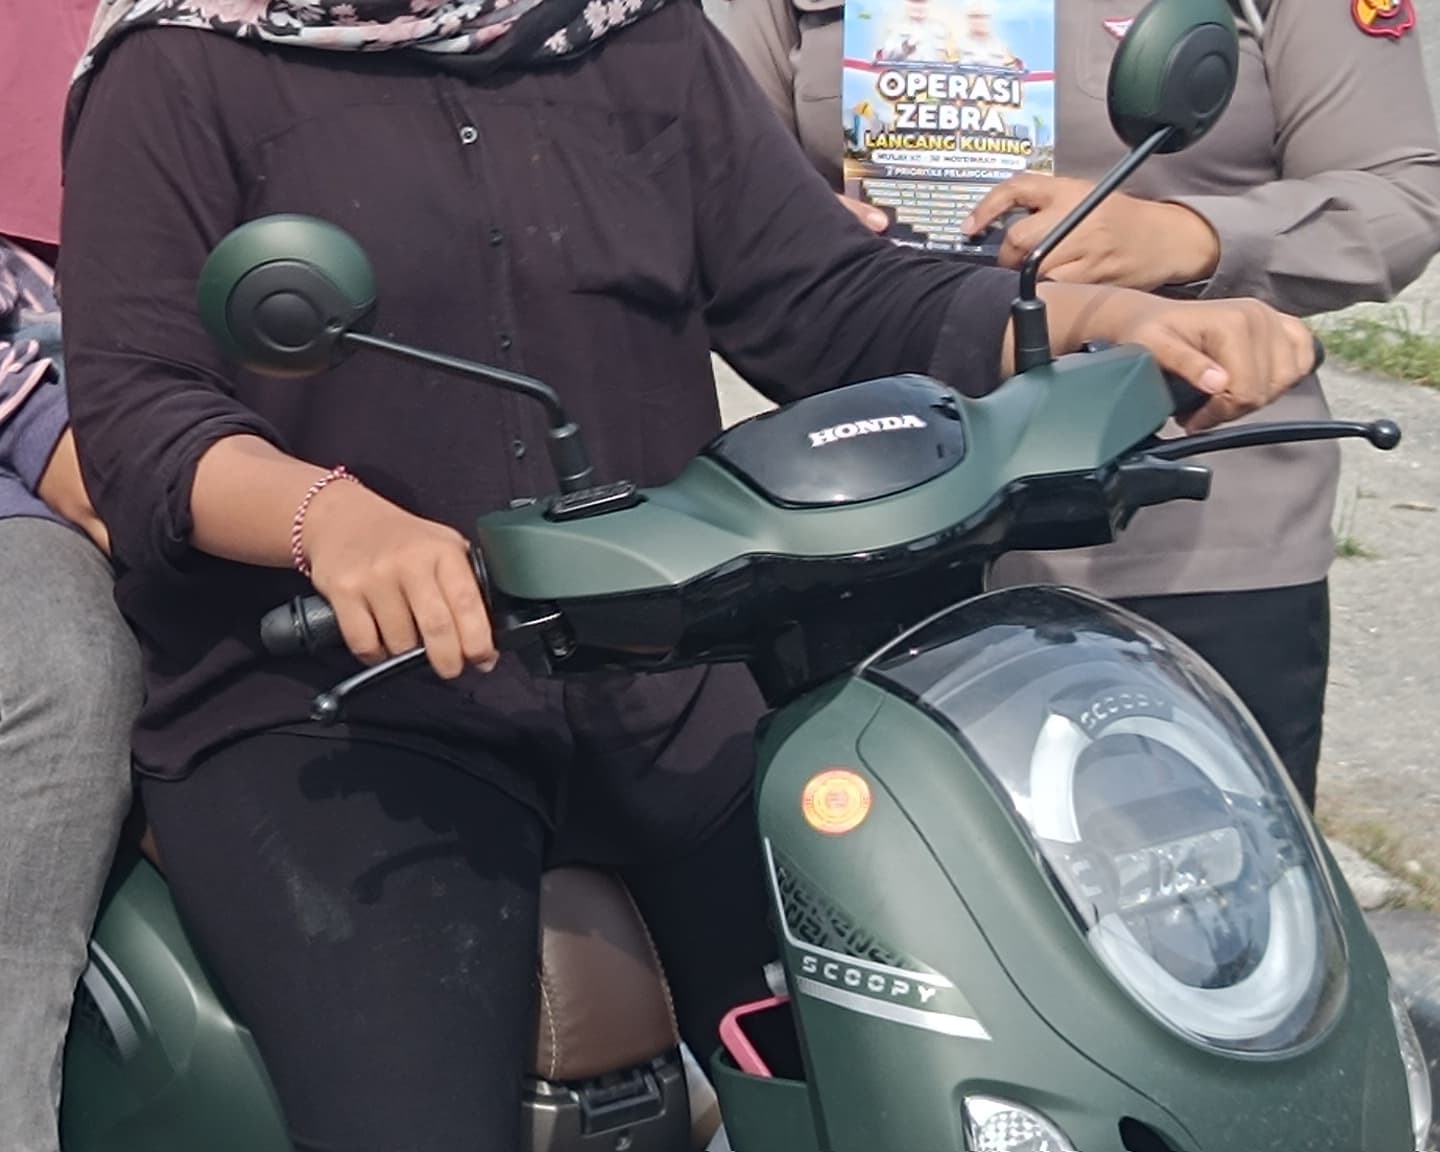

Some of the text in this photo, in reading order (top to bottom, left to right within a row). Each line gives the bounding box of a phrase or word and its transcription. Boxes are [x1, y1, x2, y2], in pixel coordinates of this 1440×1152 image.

[878, 70, 1022, 107] OPERASI
[896, 104, 1004, 132] ZEBRA
[865, 132, 1033, 155] LANCANG KUNING
[808, 414, 928, 448] HONDA
[802, 955, 937, 1003] SCOOPY
